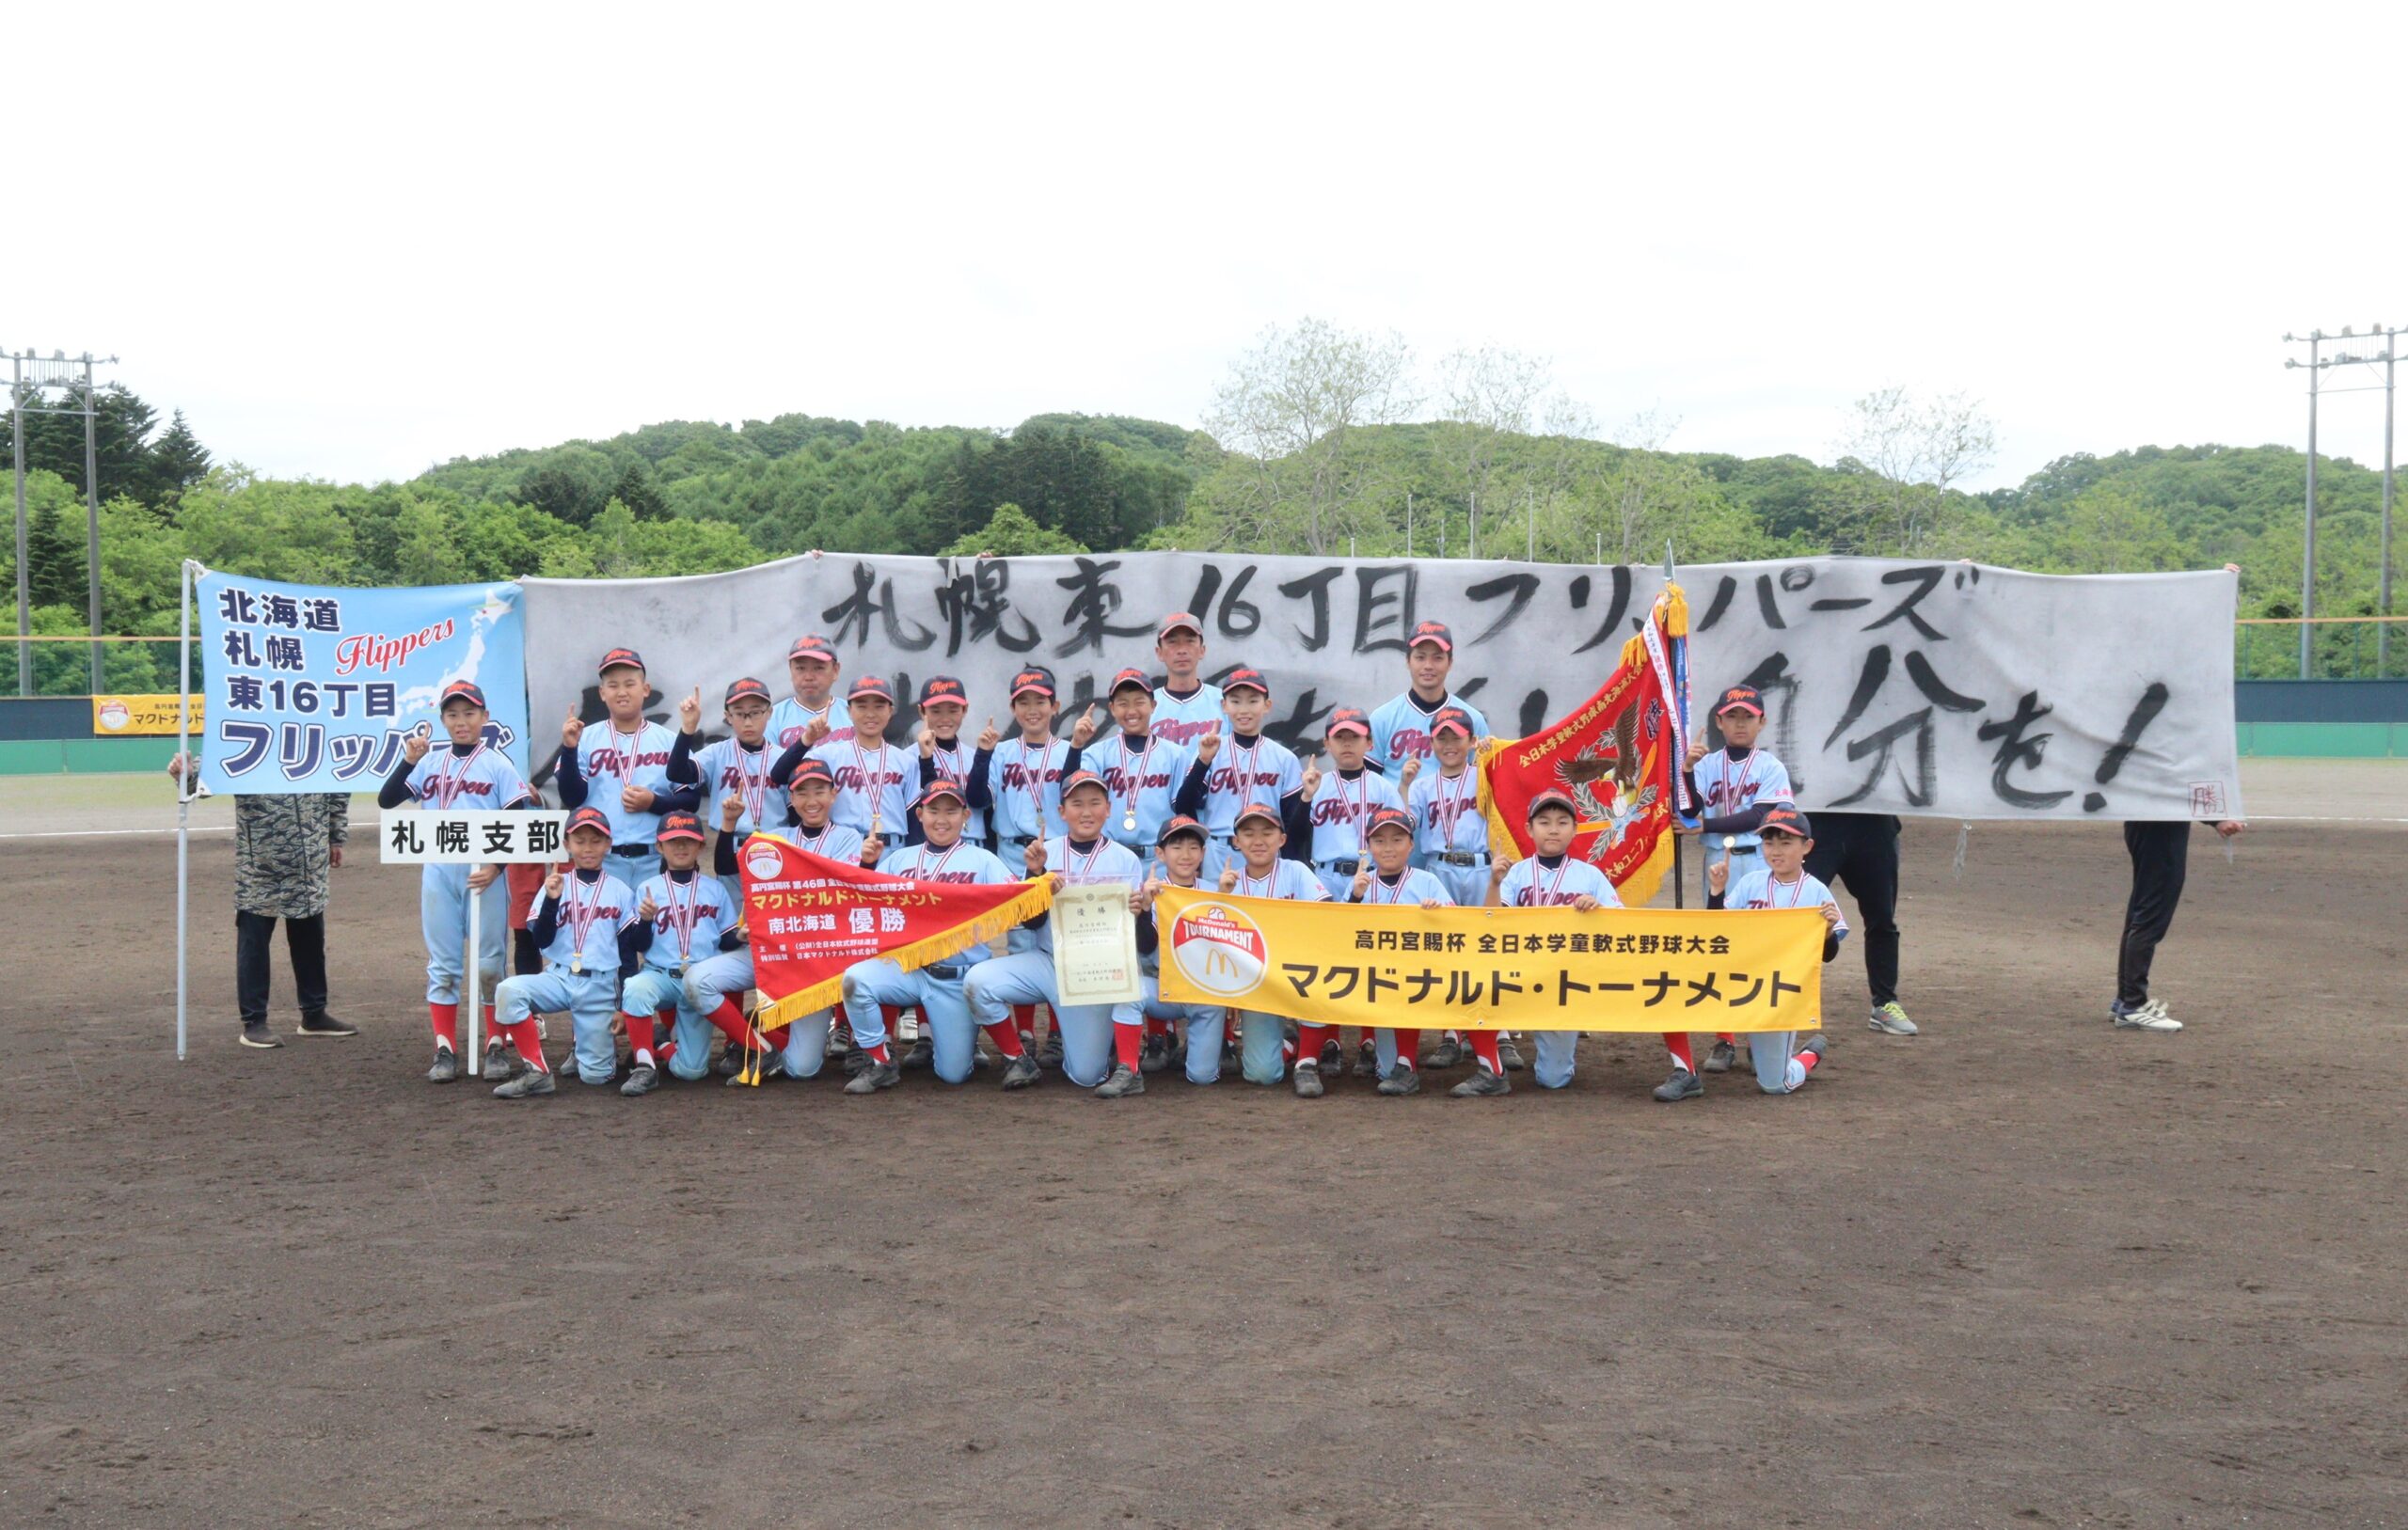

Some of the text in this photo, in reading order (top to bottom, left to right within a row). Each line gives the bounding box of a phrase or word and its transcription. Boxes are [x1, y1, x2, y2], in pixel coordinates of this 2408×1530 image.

[219, 588, 341, 633] 北海道
[821, 557, 1981, 658] 札幌東16丁目フリパーズ
[224, 629, 305, 671] 札幌
[335, 617, 455, 676] Flippers
[227, 675, 396, 718] 東16丁目
[391, 819, 561, 855] 札幌支部
[768, 907, 906, 936] 南北海道 優勝
[1183, 920, 1254, 953] TOURNAMENT
[1354, 929, 1731, 955] 高円宮賜杯 全日本学童軟式野球大会
[1280, 961, 1803, 1009] マクドナルド・トーナメント
